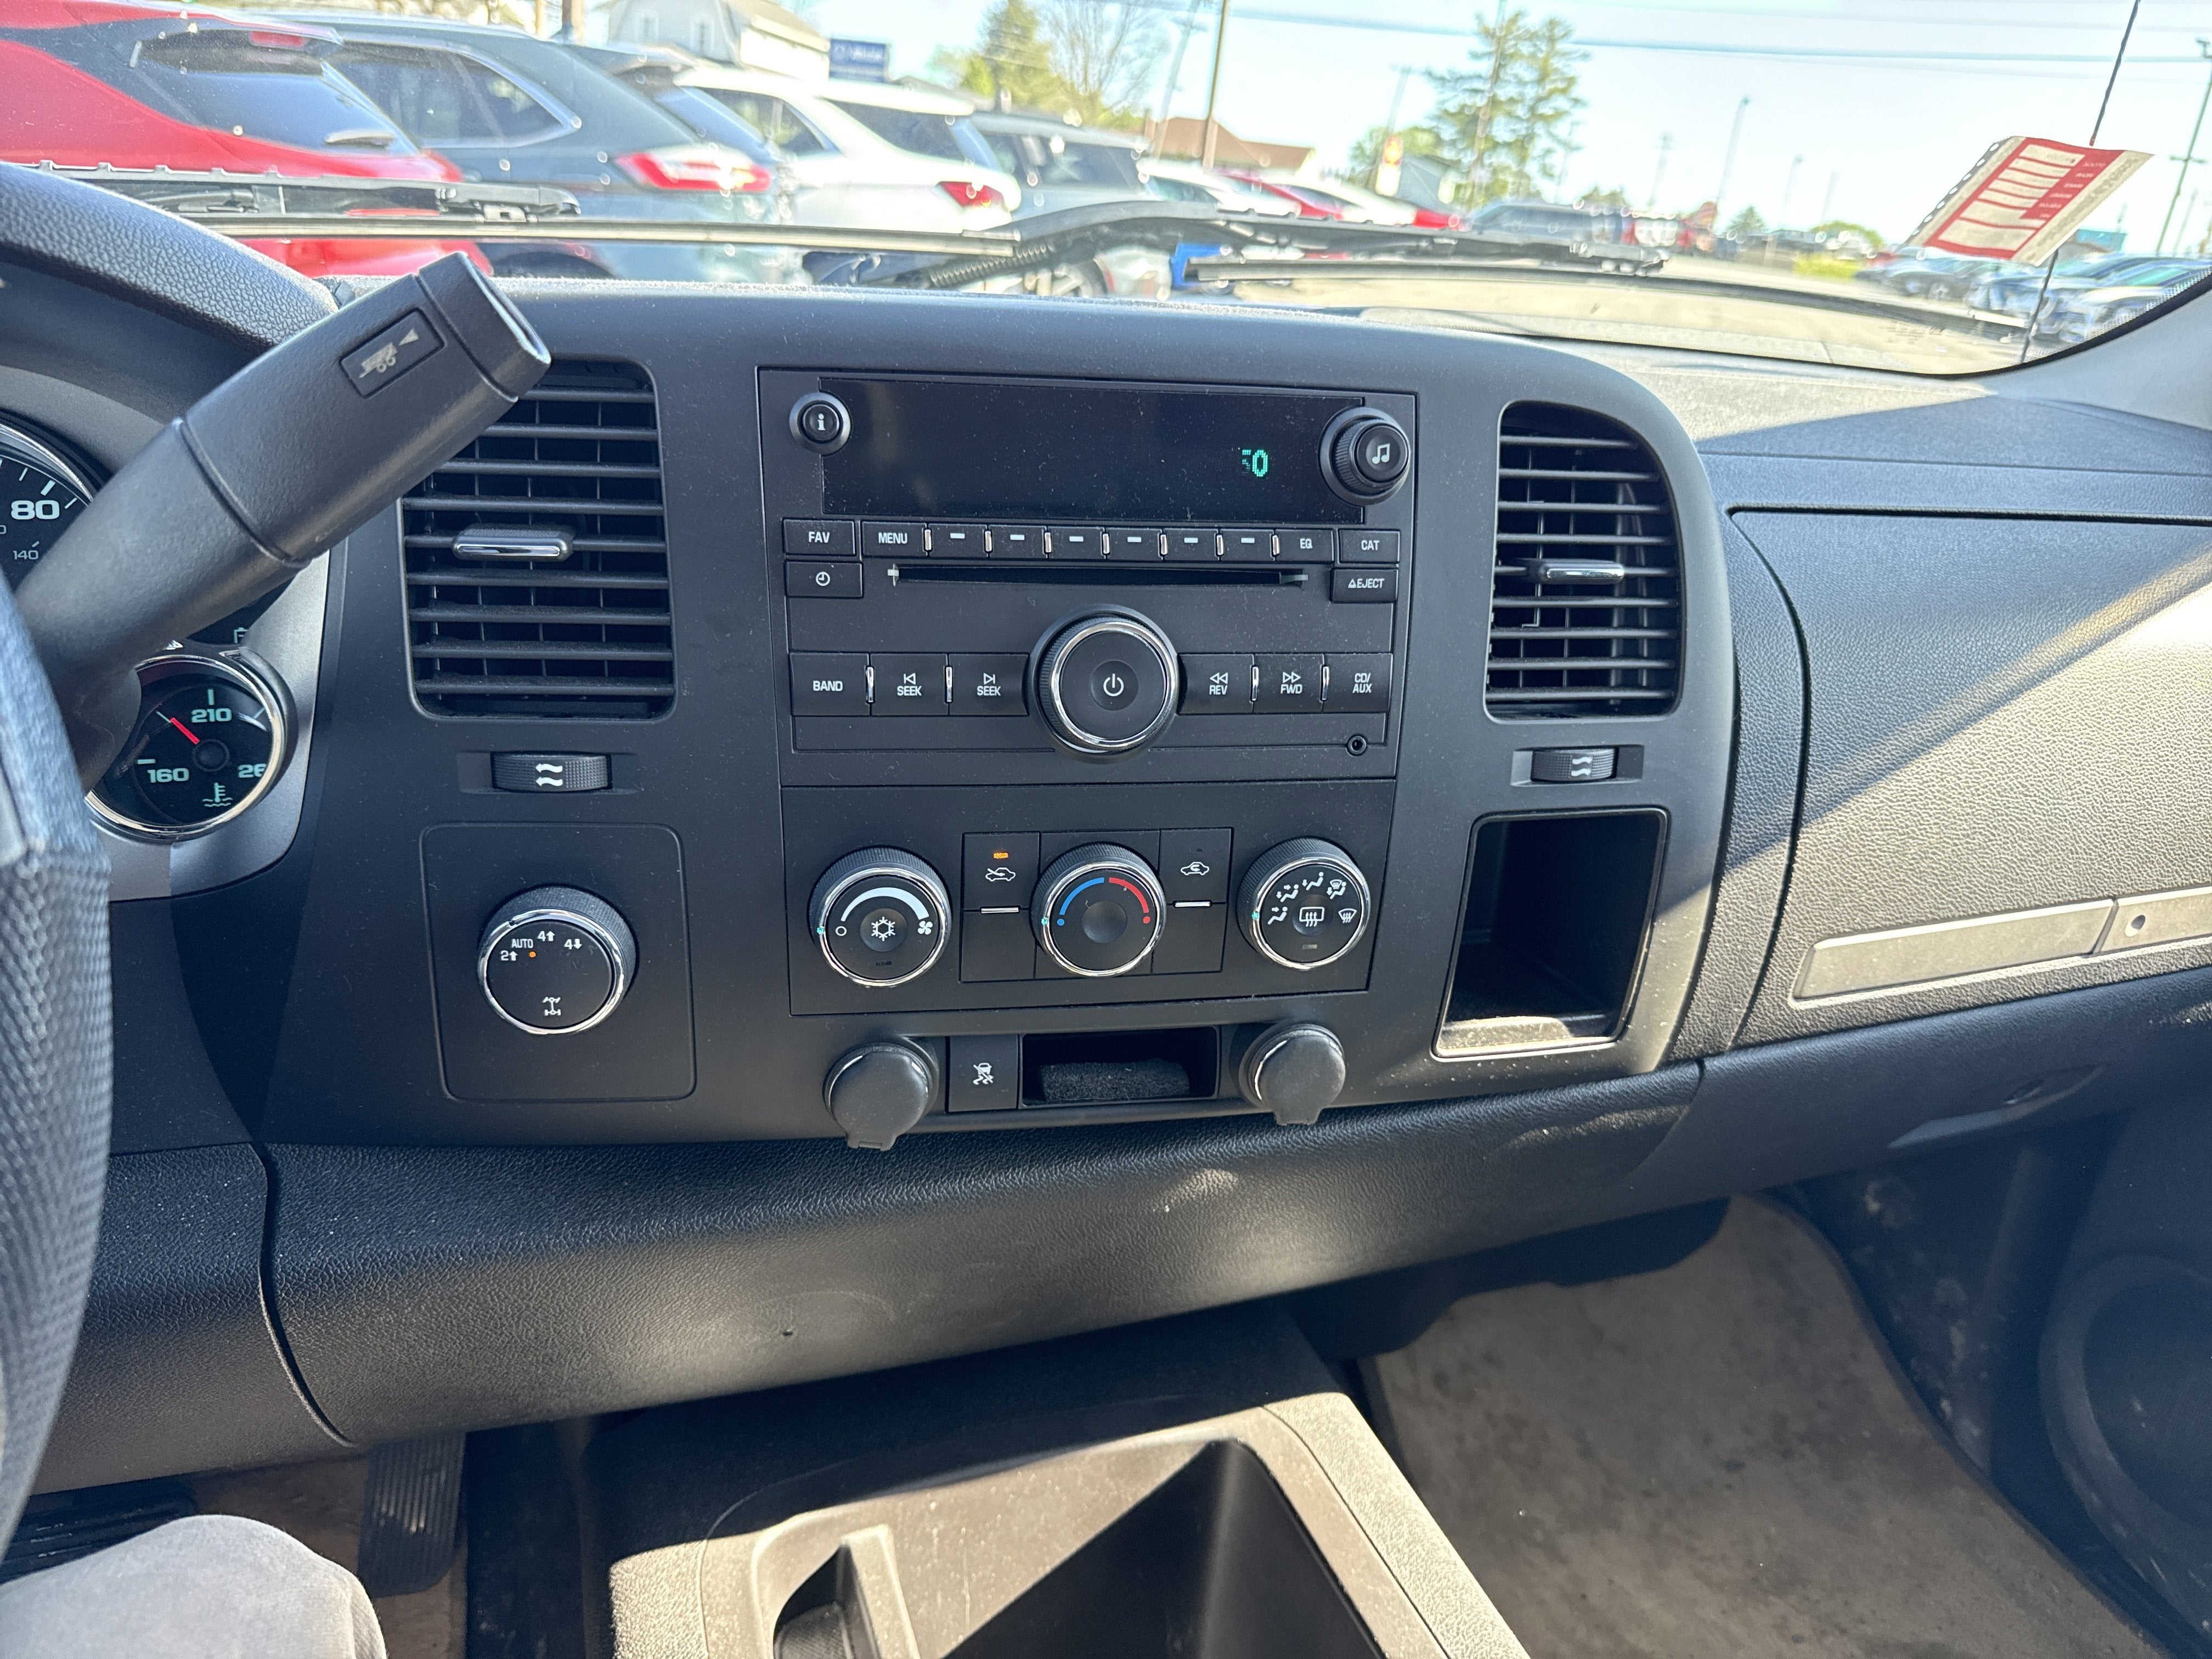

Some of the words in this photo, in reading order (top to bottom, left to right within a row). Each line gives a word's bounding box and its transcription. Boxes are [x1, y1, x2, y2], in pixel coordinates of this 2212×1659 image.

[11, 500, 60, 520] 80
[808, 531, 830, 544] FAV
[878, 532, 908, 544] MENU
[1300, 538, 1313, 549] EQ
[1361, 539, 1380, 551] CAT
[13, 550, 39, 560] 140
[1356, 578, 1385, 589] EJECT
[1354, 673, 1371, 683] CD/
[812, 680, 843, 692] BAND
[897, 685, 922, 696] SEEK
[977, 685, 1001, 696] SEEK
[1209, 685, 1228, 695] REV
[1280, 684, 1303, 694] FWD
[1352, 683, 1373, 693] AUX
[191, 708, 232, 723] 210
[147, 768, 189, 783] 160
[537, 930, 546, 942] 4
[511, 938, 534, 949] AUTO
[564, 939, 573, 950] 4
[500, 950, 509, 961] 2
